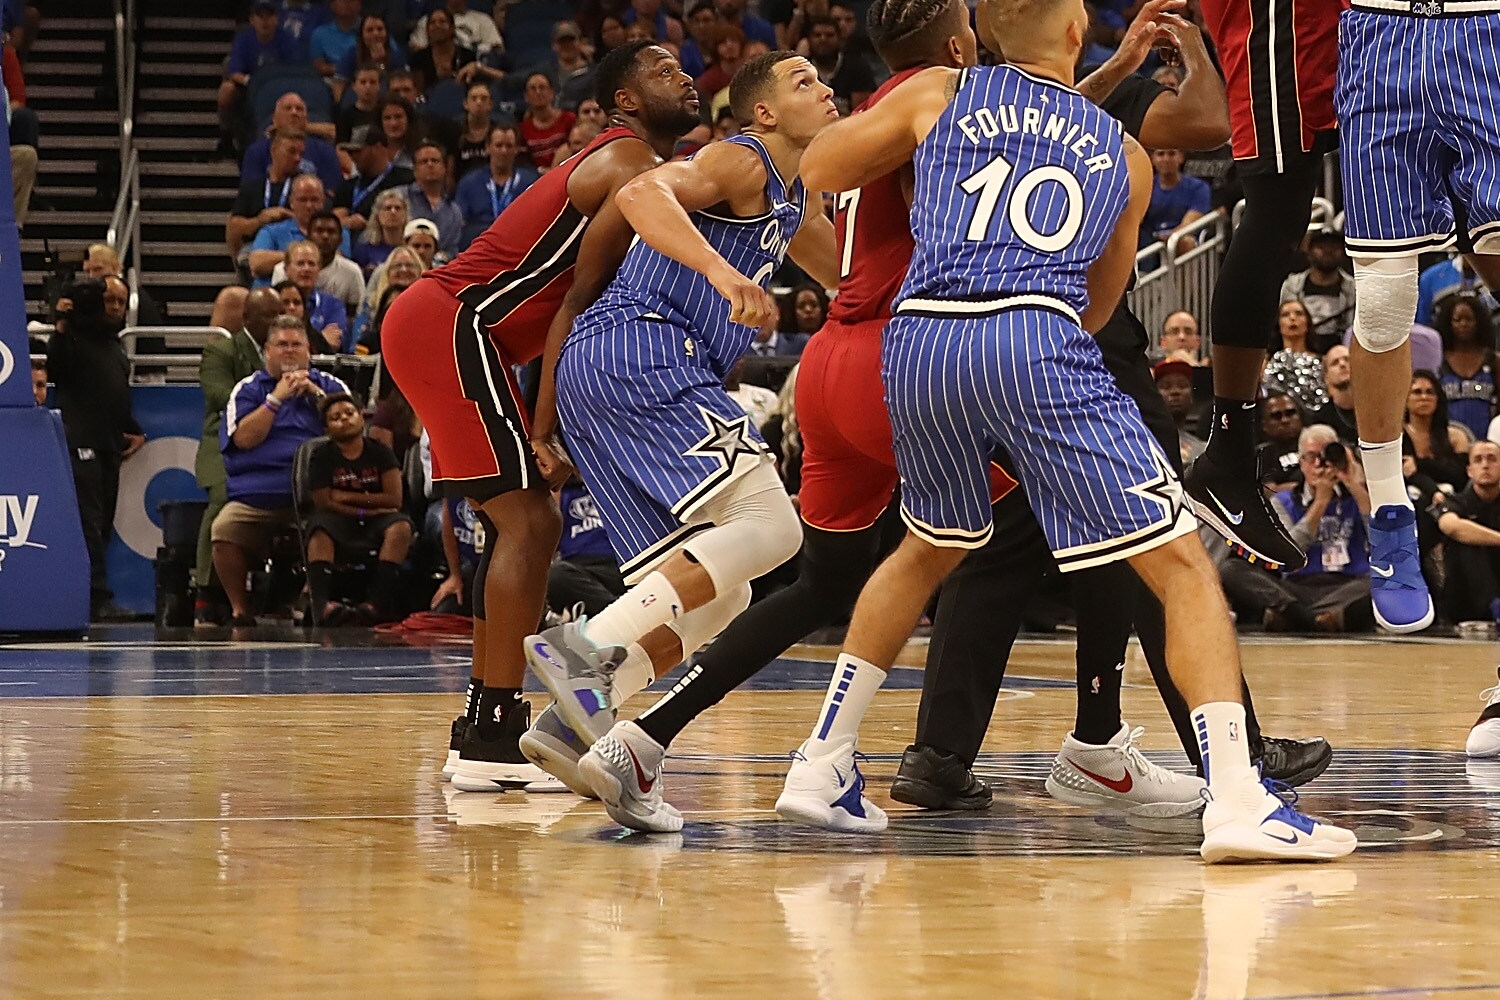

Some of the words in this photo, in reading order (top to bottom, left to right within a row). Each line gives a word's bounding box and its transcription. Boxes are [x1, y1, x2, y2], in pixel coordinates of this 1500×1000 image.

[956, 104, 1114, 174] FOURNIER
[833, 187, 861, 278] 7
[961, 155, 1084, 253] 10
